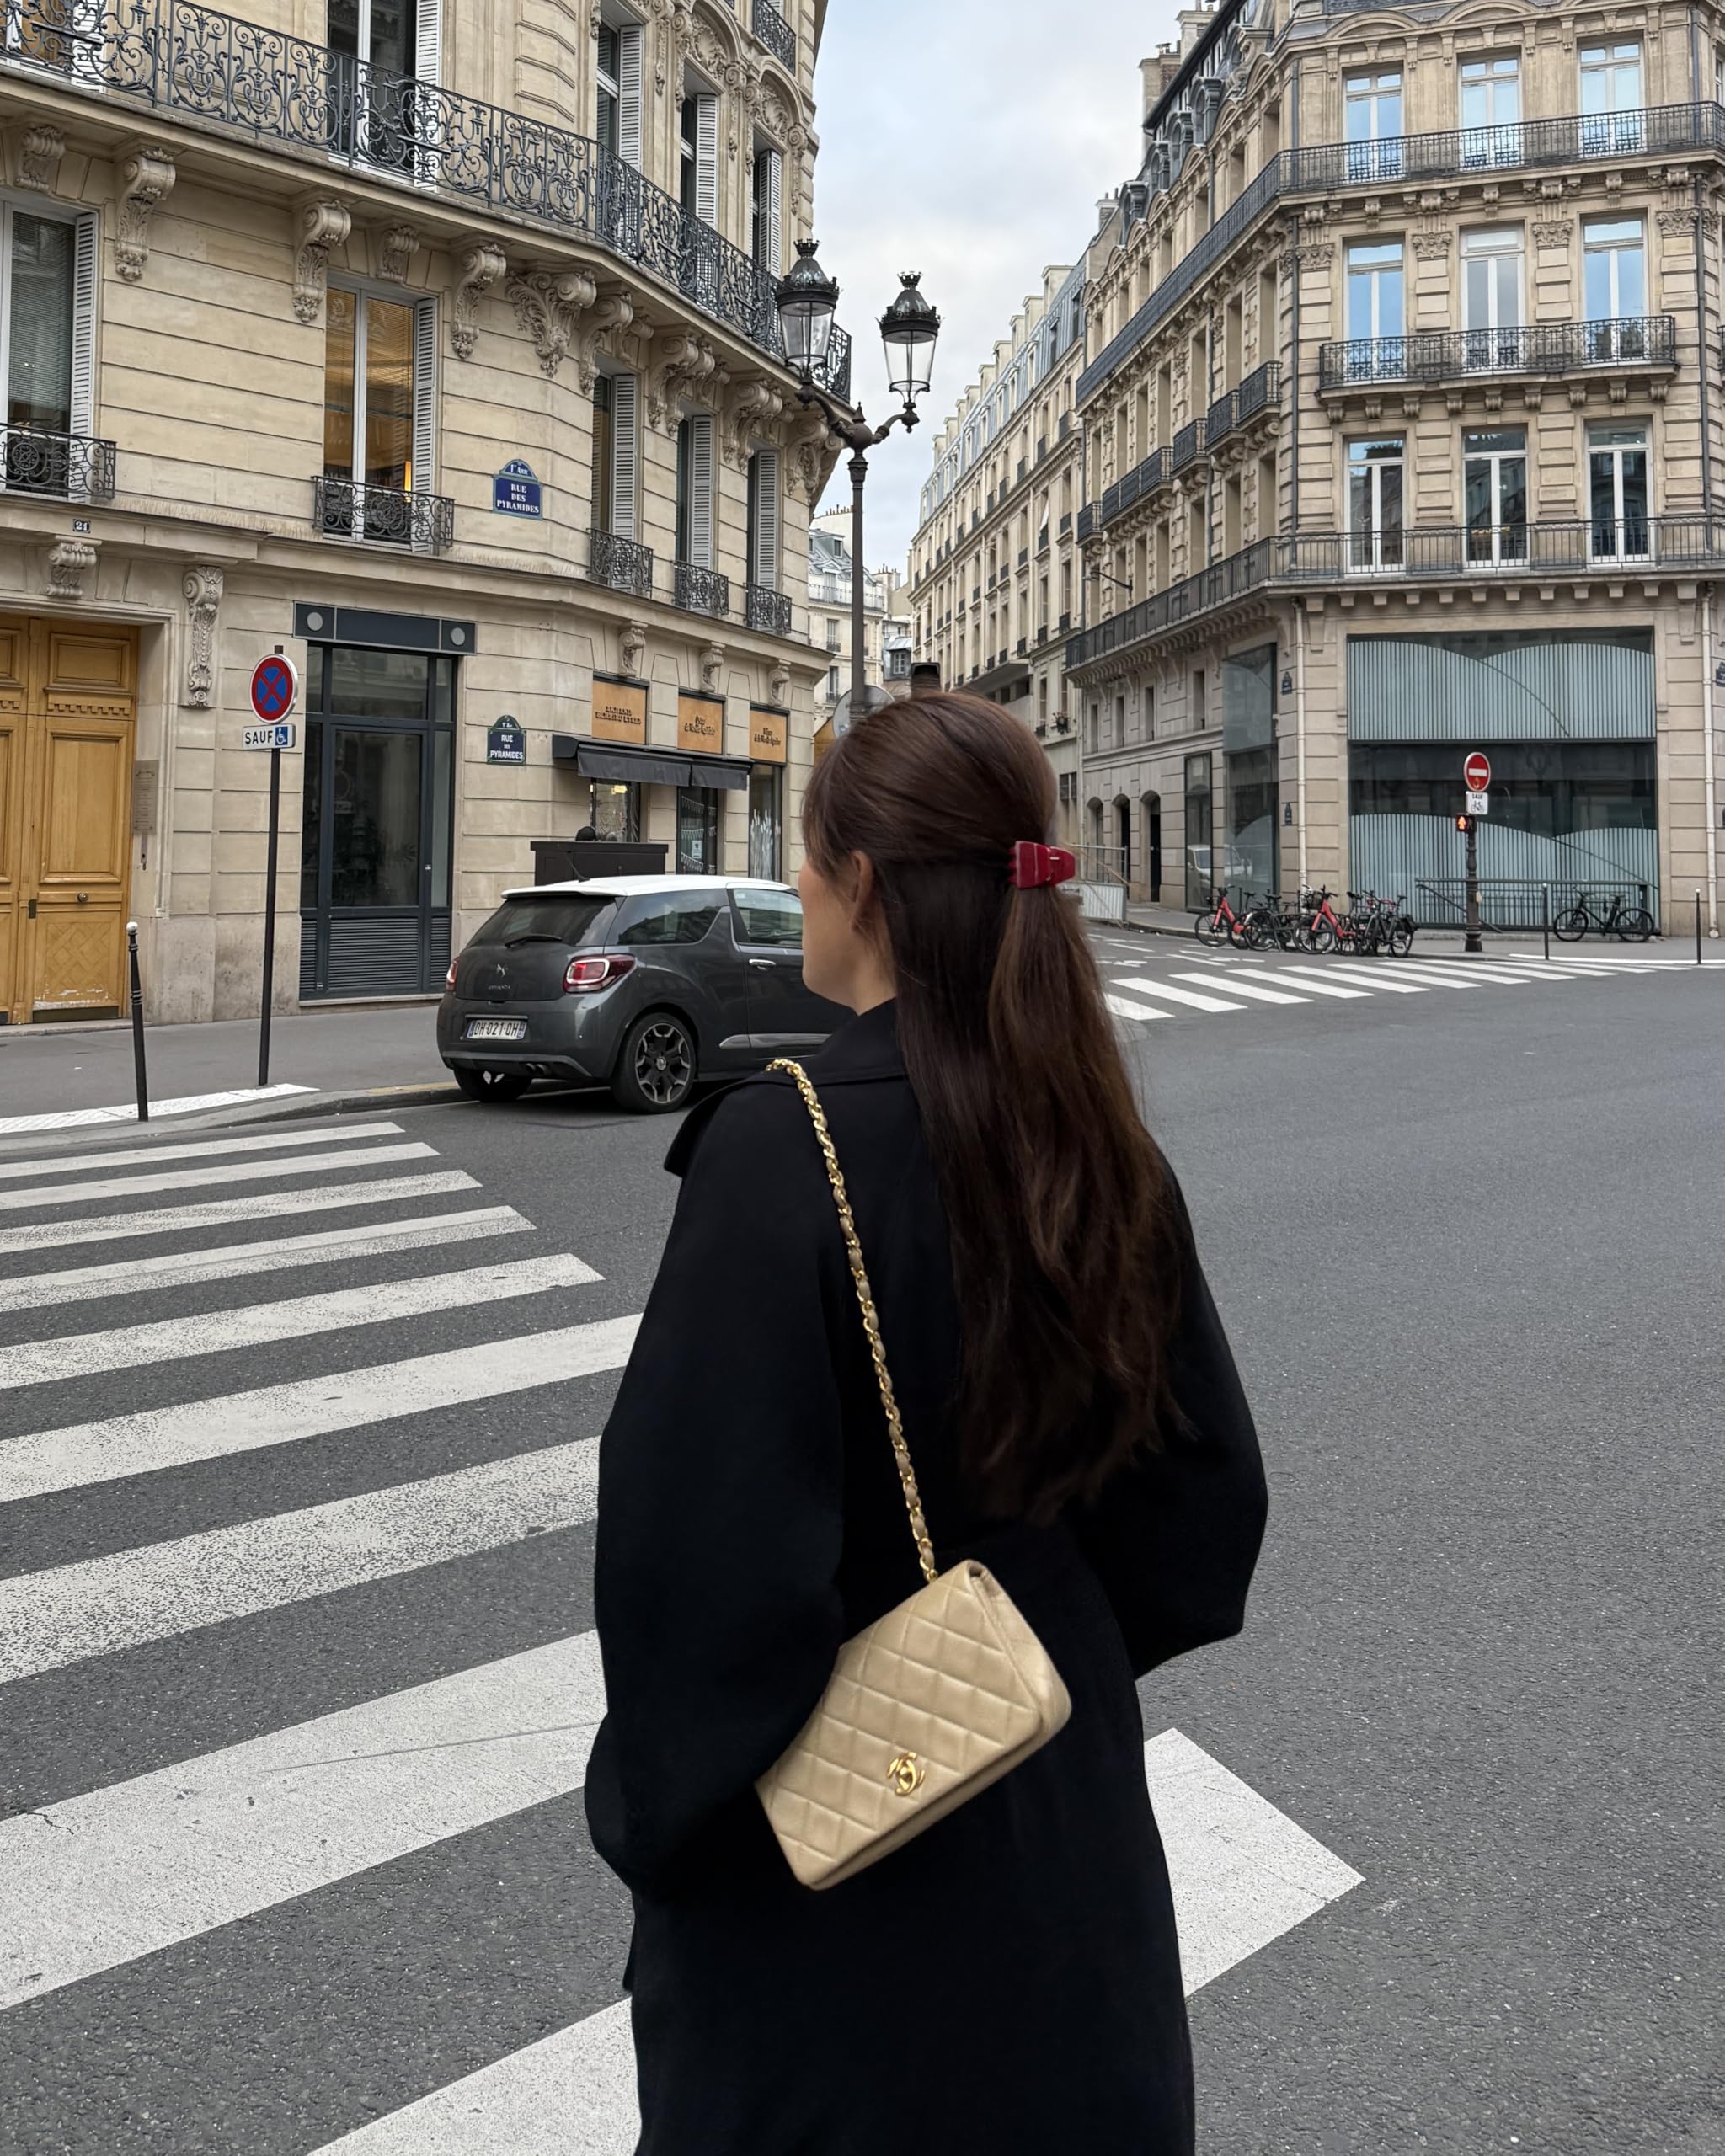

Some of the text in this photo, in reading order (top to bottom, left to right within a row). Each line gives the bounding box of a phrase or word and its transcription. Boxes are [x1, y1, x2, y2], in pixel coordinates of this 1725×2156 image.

[510, 483, 526, 494] RUE
[511, 493, 526, 502] DES
[497, 499, 539, 513] PYRAMIDES
[76, 521, 88, 531] 21
[245, 730, 274, 744] SAUF
[490, 750, 523, 759] PYRAMIDES
